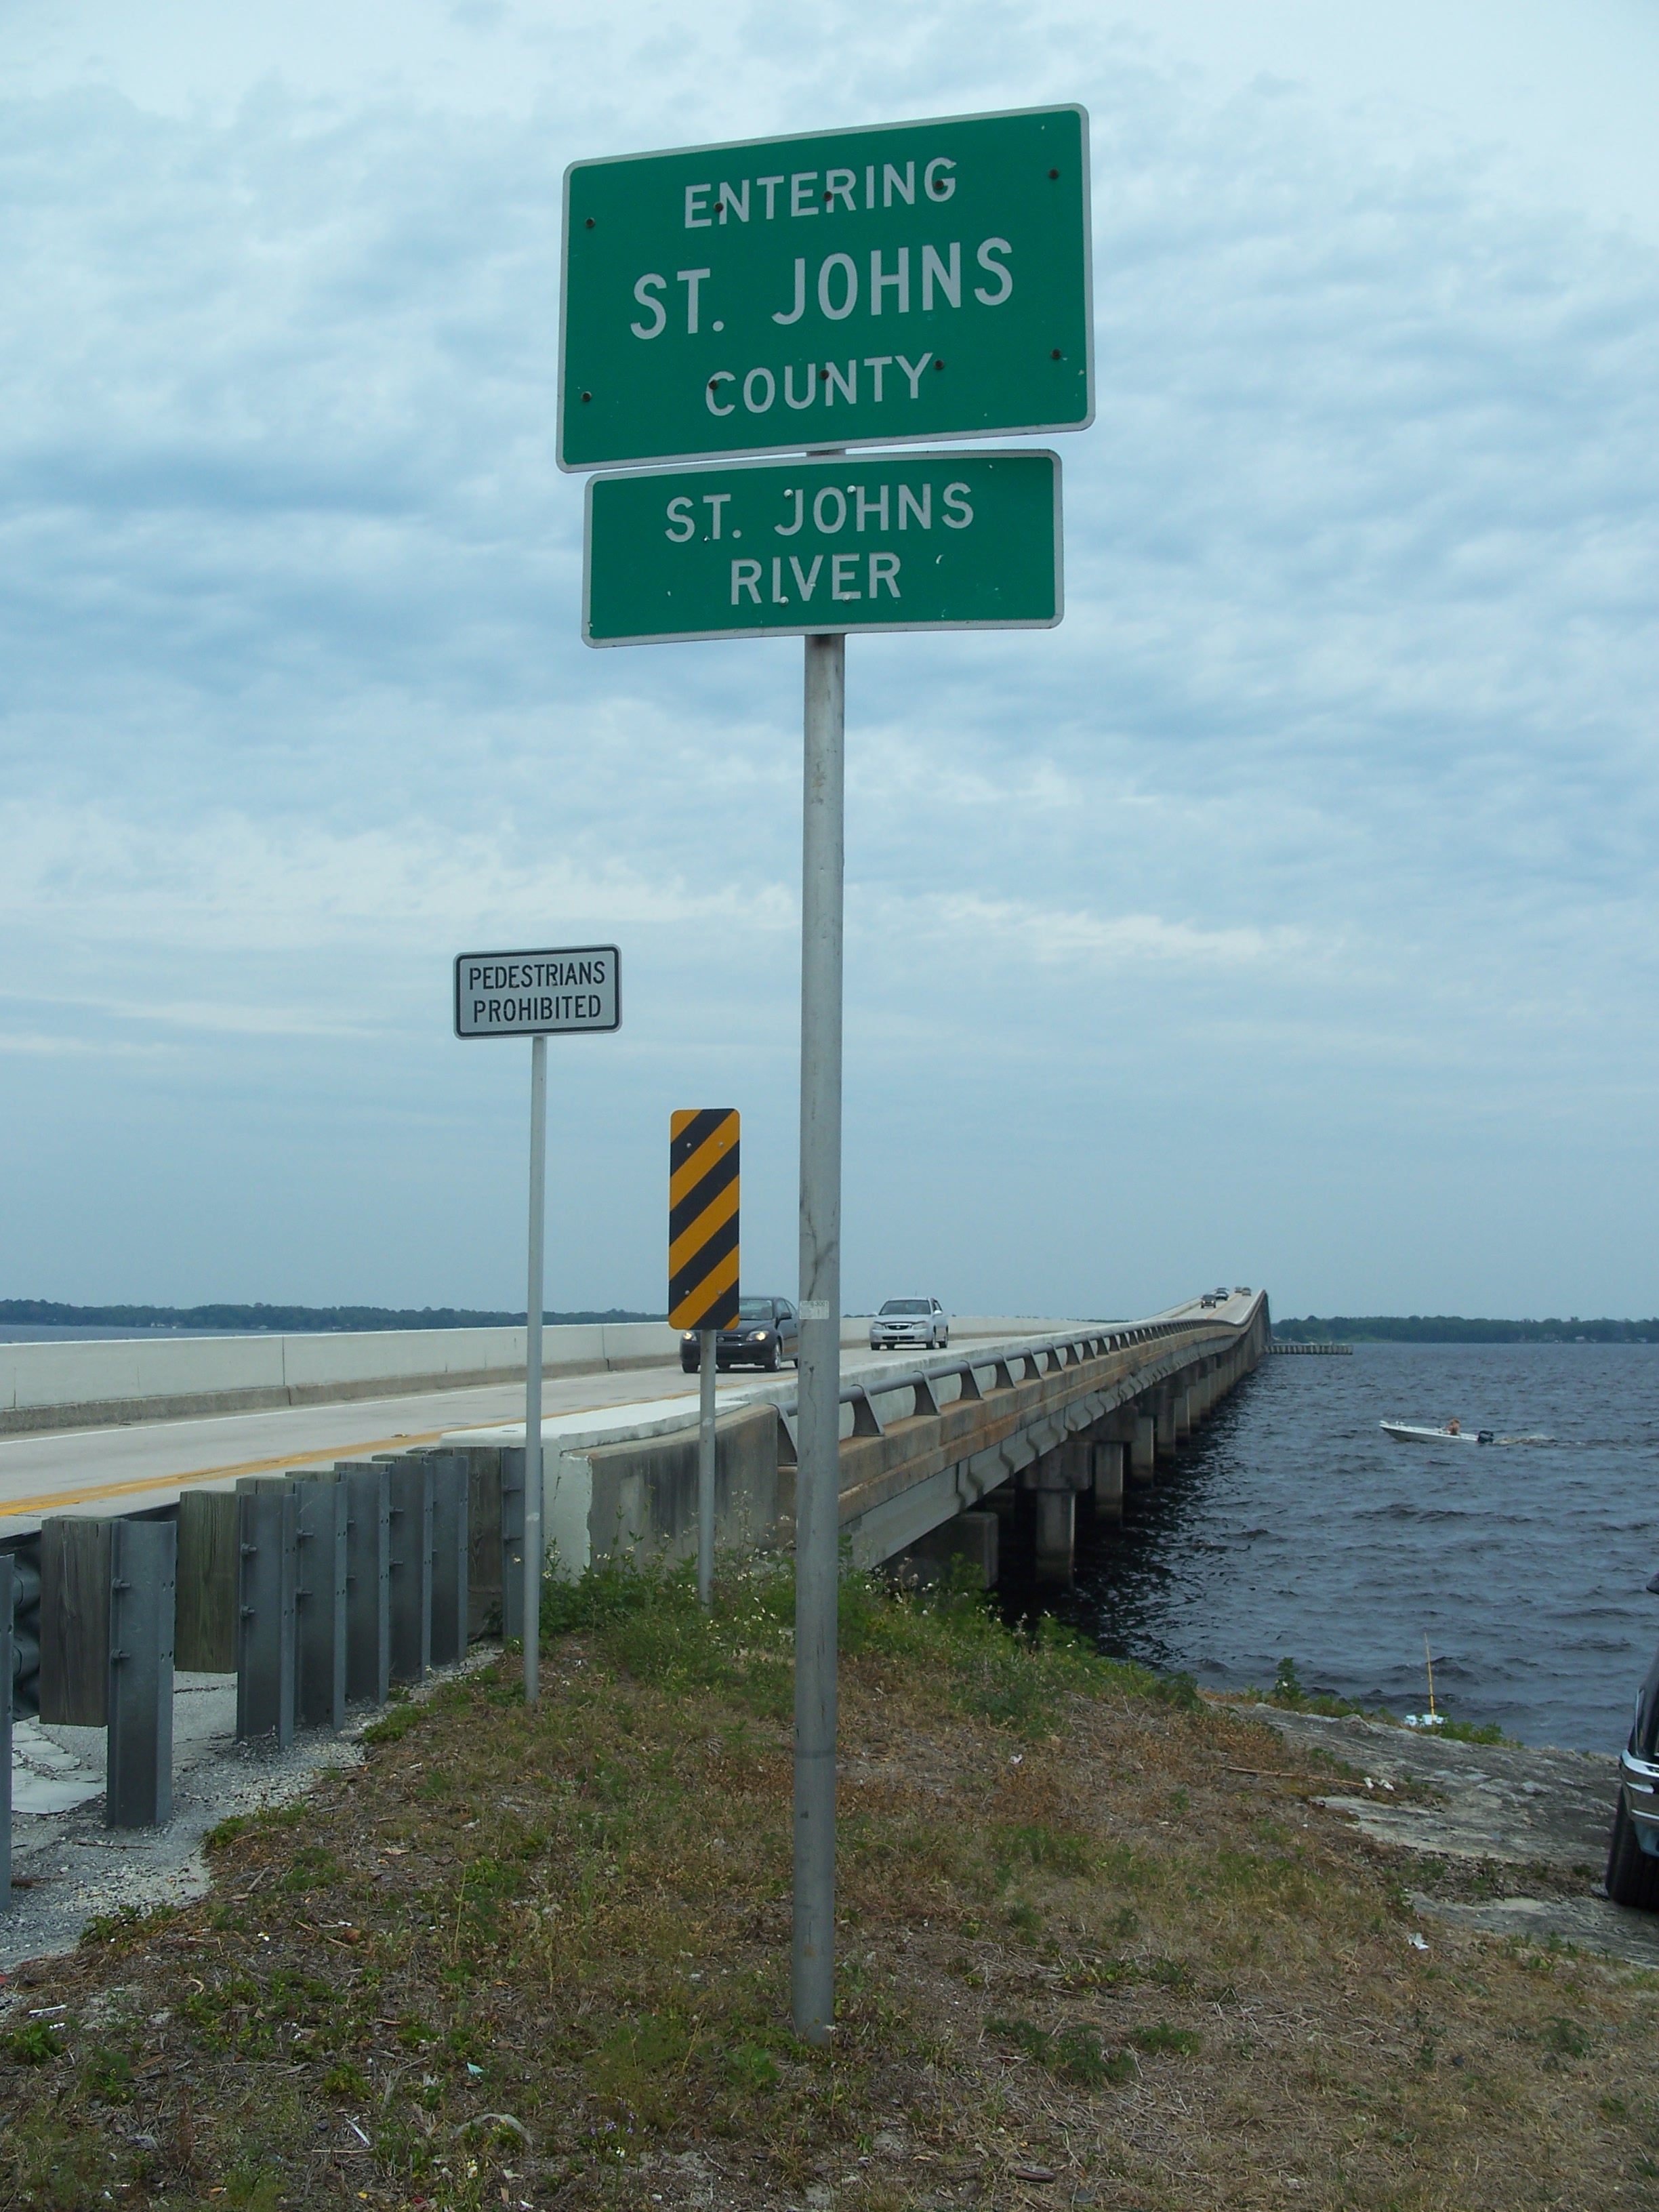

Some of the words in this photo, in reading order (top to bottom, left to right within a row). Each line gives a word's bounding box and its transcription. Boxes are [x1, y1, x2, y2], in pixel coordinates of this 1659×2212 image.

[684, 157, 957, 228] ENTERING
[631, 268, 724, 340] ST.
[771, 237, 1013, 325] JOHNS
[705, 352, 933, 416] COUNTY
[665, 493, 742, 543] ST.
[774, 483, 974, 536] JOHNS
[731, 552, 901, 605] RIVER
[469, 961, 605, 991] PEDESTRIANS
[474, 994, 602, 1023] PROHIBITED
